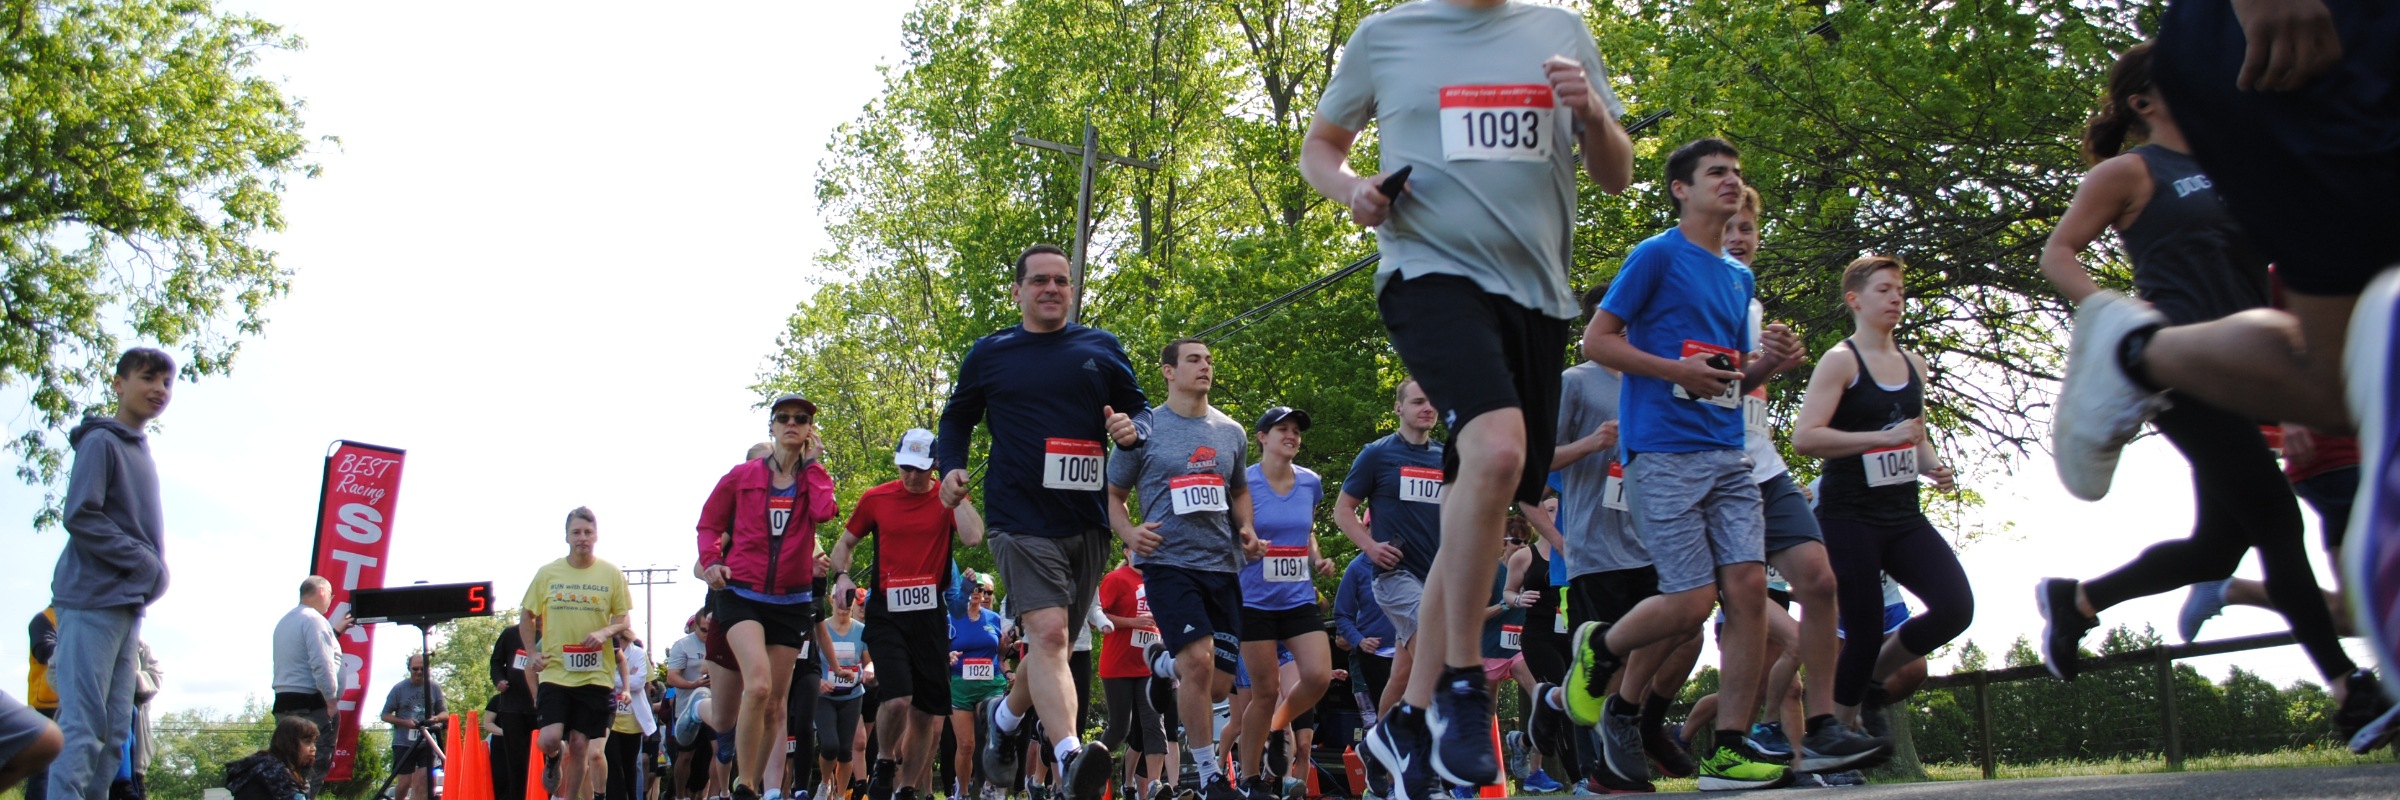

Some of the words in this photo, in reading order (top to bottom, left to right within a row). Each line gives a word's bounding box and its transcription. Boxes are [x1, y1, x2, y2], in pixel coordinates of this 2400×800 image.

[1462, 111, 1539, 149] 1093
[338, 453, 399, 478] BEST
[1059, 456, 1098, 483] 1009
[1878, 450, 1914, 478] 1048
[336, 474, 385, 505] Racing
[1182, 486, 1219, 507] 1090
[1410, 479, 1442, 498] 1107
[1273, 558, 1303, 577] 1091
[582, 584, 609, 592] EAGLES
[895, 586, 930, 606] 1098
[469, 586, 485, 612] 5
[569, 652, 598, 668] 1088
[968, 665, 990, 677] 1022
